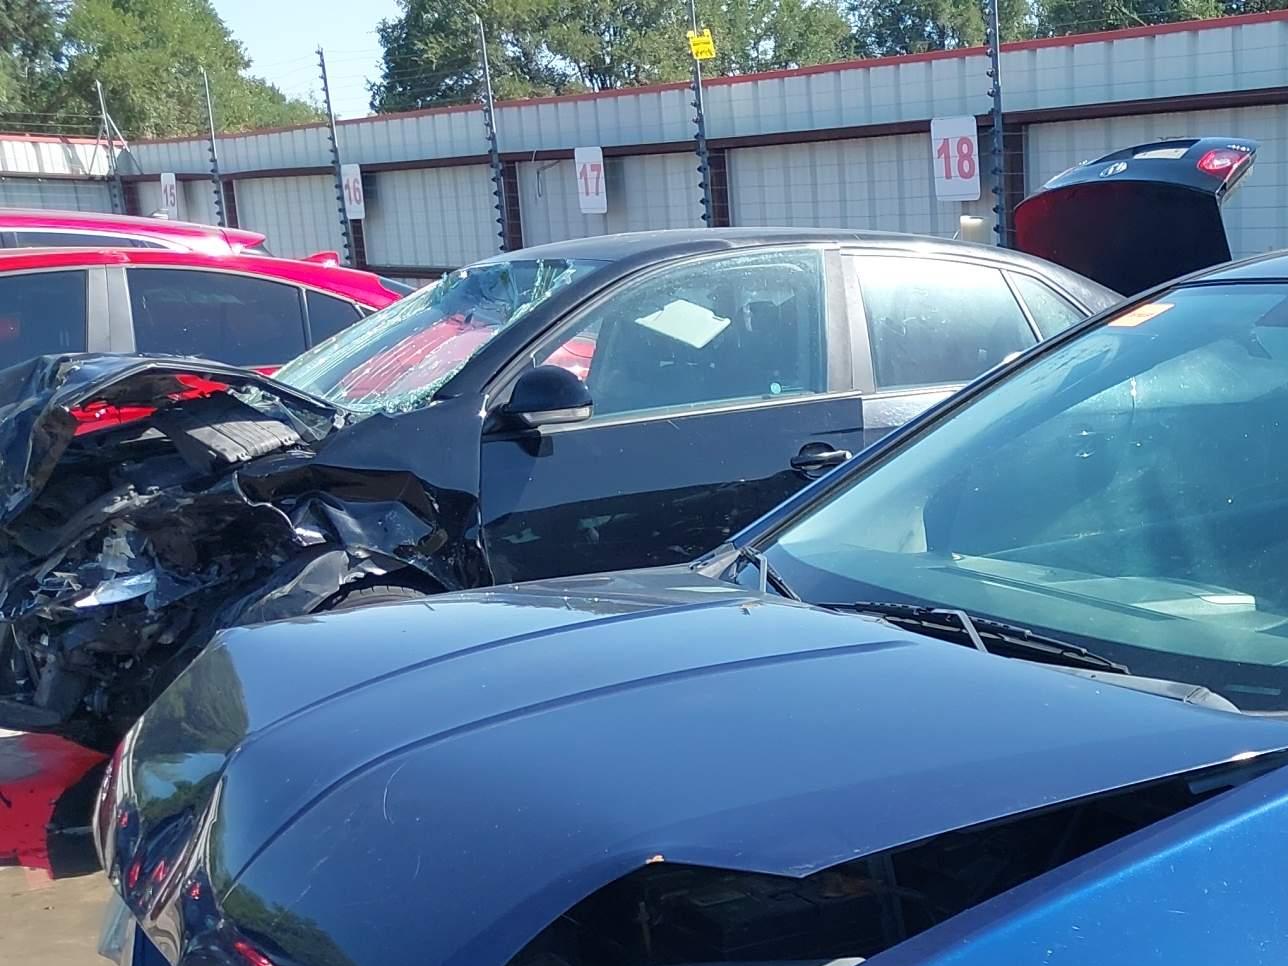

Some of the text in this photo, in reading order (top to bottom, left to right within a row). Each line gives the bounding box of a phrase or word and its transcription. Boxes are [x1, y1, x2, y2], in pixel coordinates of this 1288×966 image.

[937, 136, 976, 180] 18
[163, 184, 176, 207] 15
[344, 177, 362, 206] 16
[579, 162, 602, 197] 17
